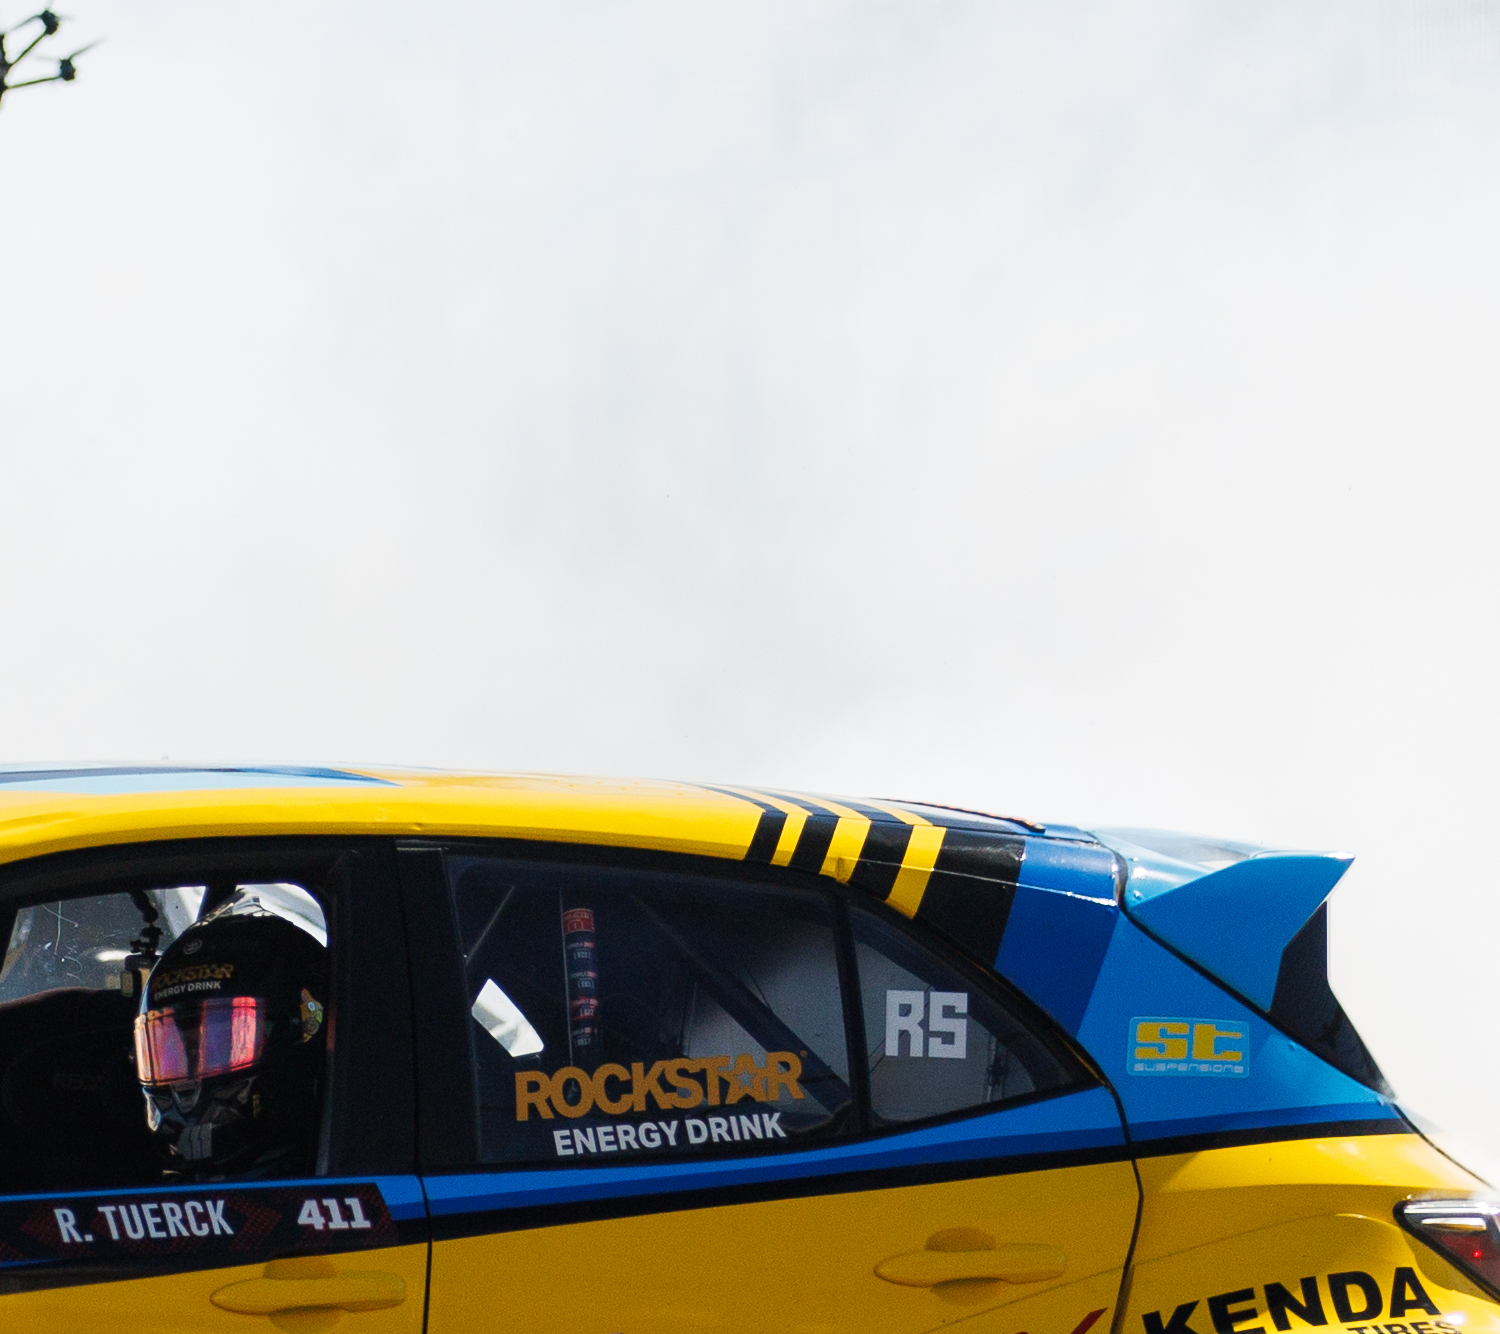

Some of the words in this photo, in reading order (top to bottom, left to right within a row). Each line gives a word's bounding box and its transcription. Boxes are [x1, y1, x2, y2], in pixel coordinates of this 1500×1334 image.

[187, 980, 222, 993] DRINK
[884, 989, 969, 1060] RS
[514, 1051, 806, 1122] ROCKSTAR
[552, 1120, 679, 1157] ENERGY
[685, 1112, 788, 1145] DRINK
[54, 1208, 94, 1244] R.
[98, 1200, 234, 1241] TUERCK
[297, 1197, 372, 1231] 411
